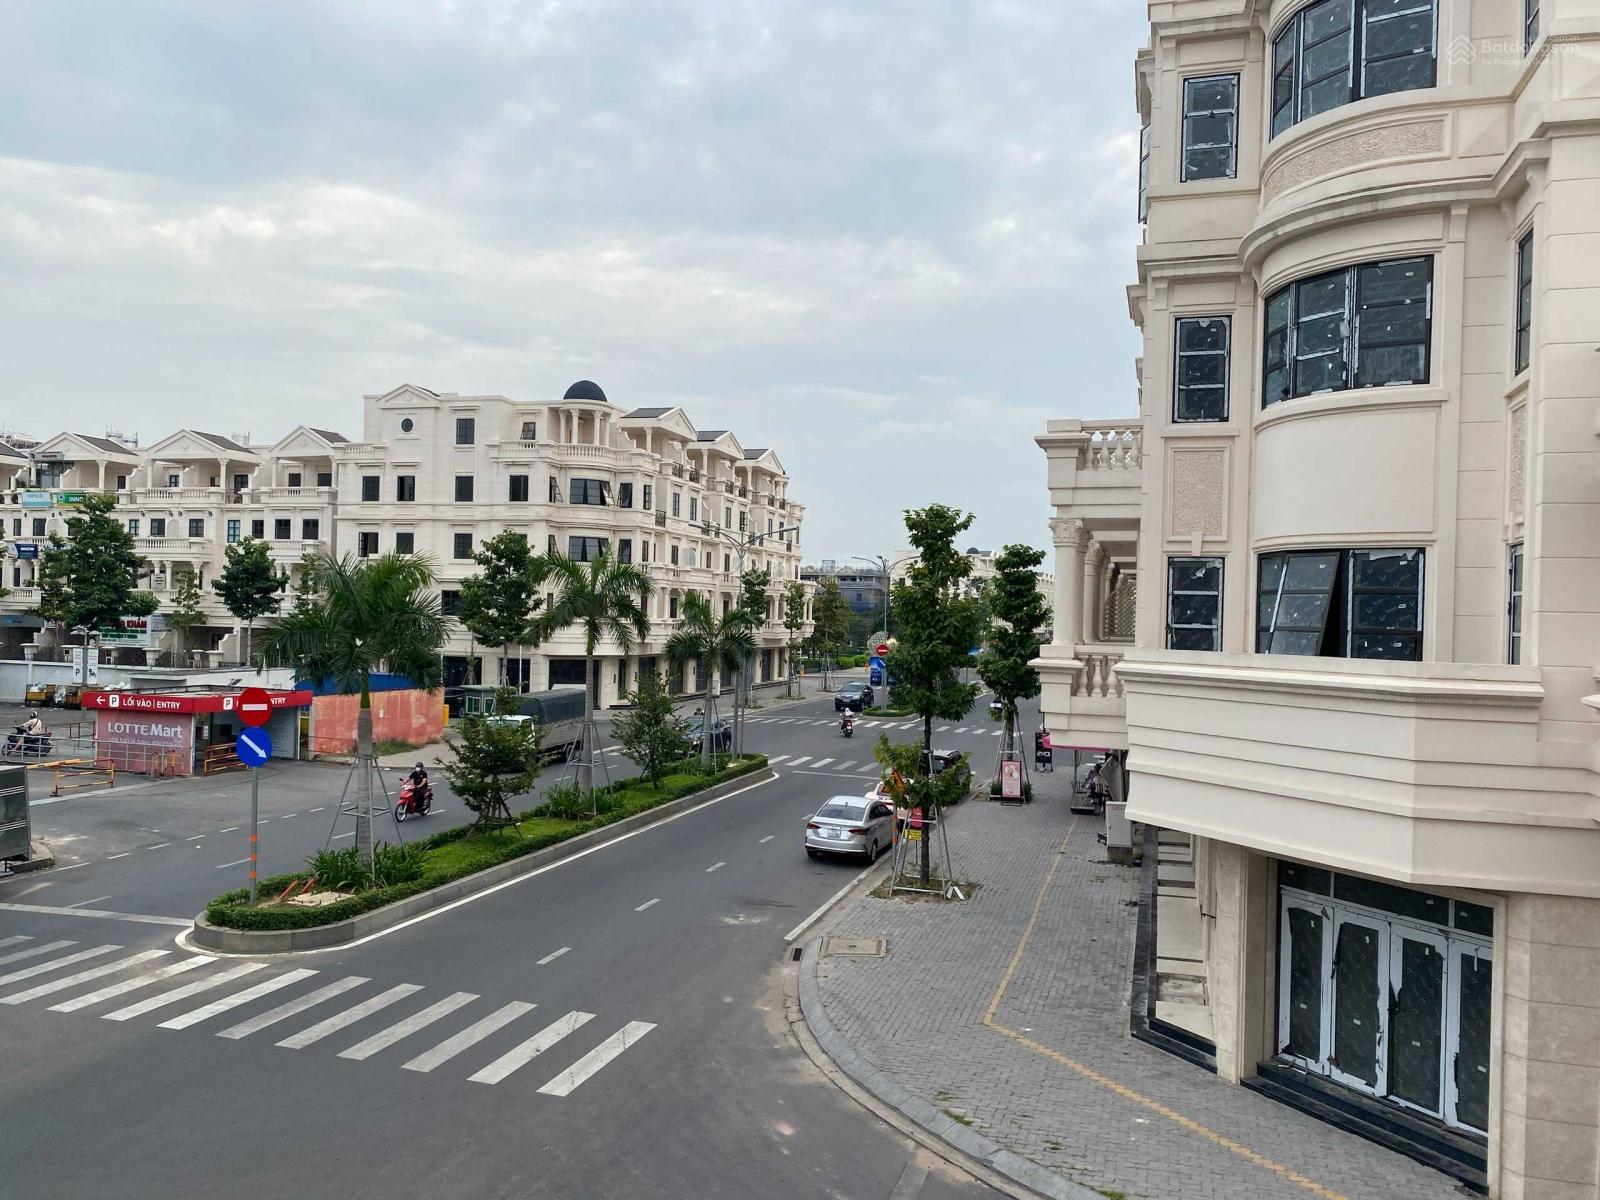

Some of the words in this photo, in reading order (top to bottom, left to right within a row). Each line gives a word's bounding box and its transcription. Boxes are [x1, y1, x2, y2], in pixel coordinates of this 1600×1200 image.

[122, 696, 135, 706] LỐI
[136, 698, 151, 708] VÀO
[156, 700, 181, 709] ENTRY
[270, 697, 287, 705] NTRY
[108, 722, 149, 736] LOTTE
[150, 723, 183, 738] Mart
